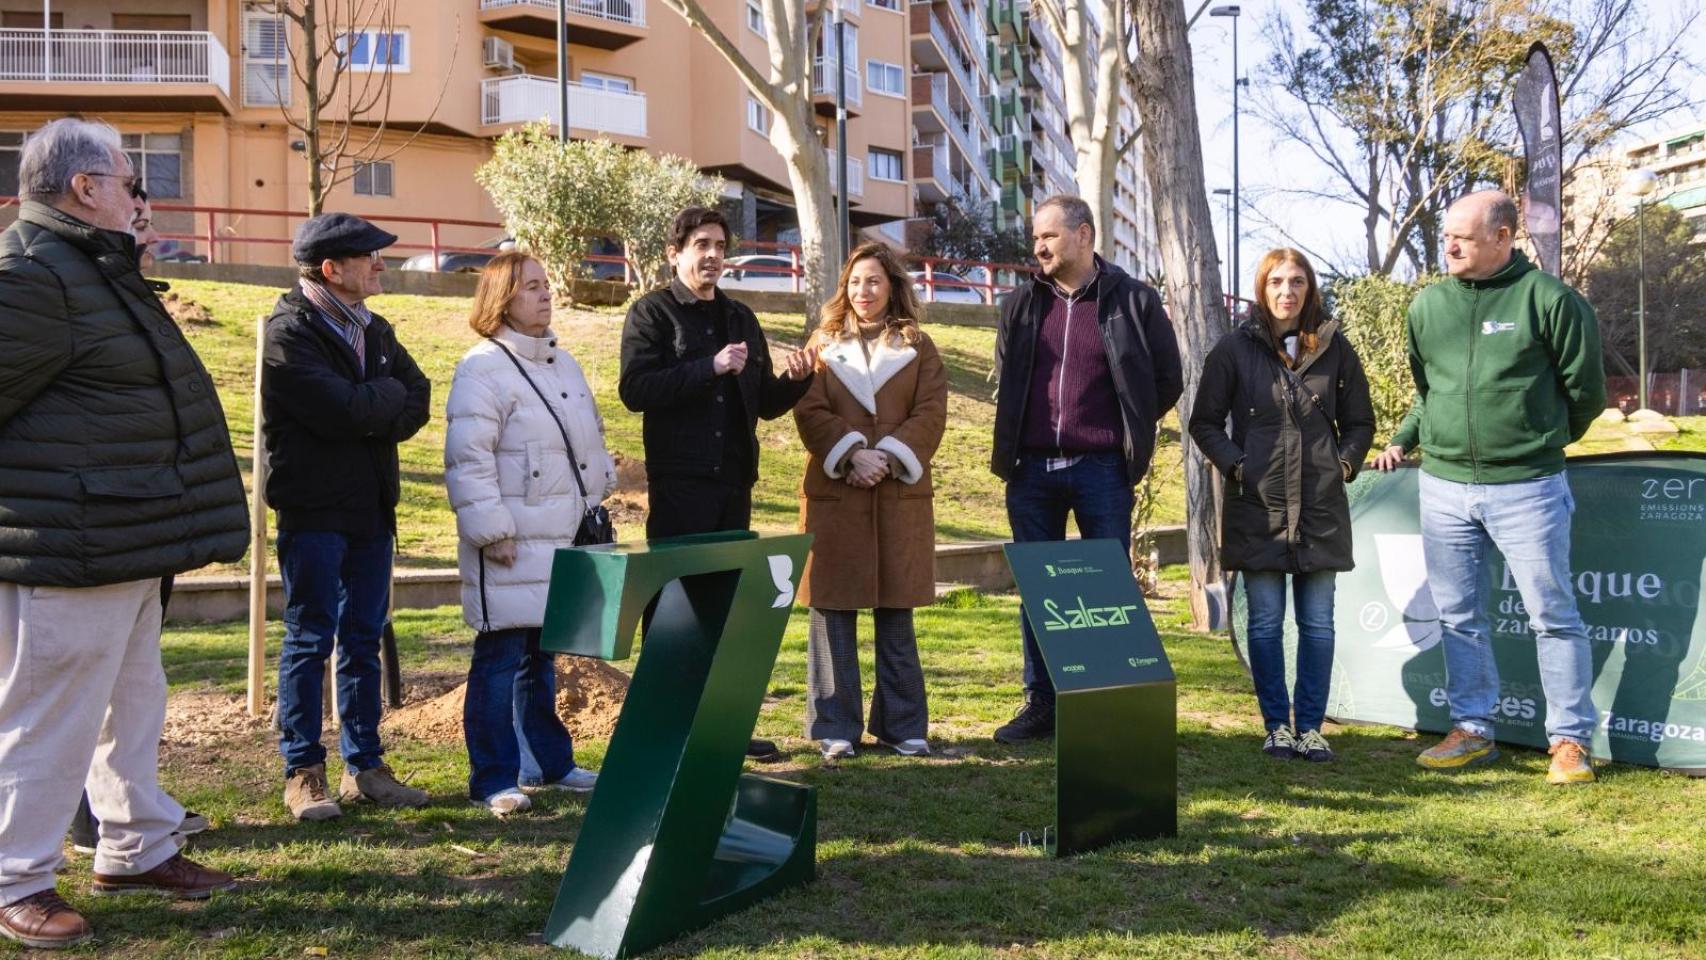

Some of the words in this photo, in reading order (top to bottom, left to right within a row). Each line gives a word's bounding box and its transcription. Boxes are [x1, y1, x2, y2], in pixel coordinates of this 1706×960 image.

[1640, 512, 1703, 520] ZARAGOZA
[1499, 595, 1525, 615] de
[1600, 710, 1705, 742] Zaragoza
